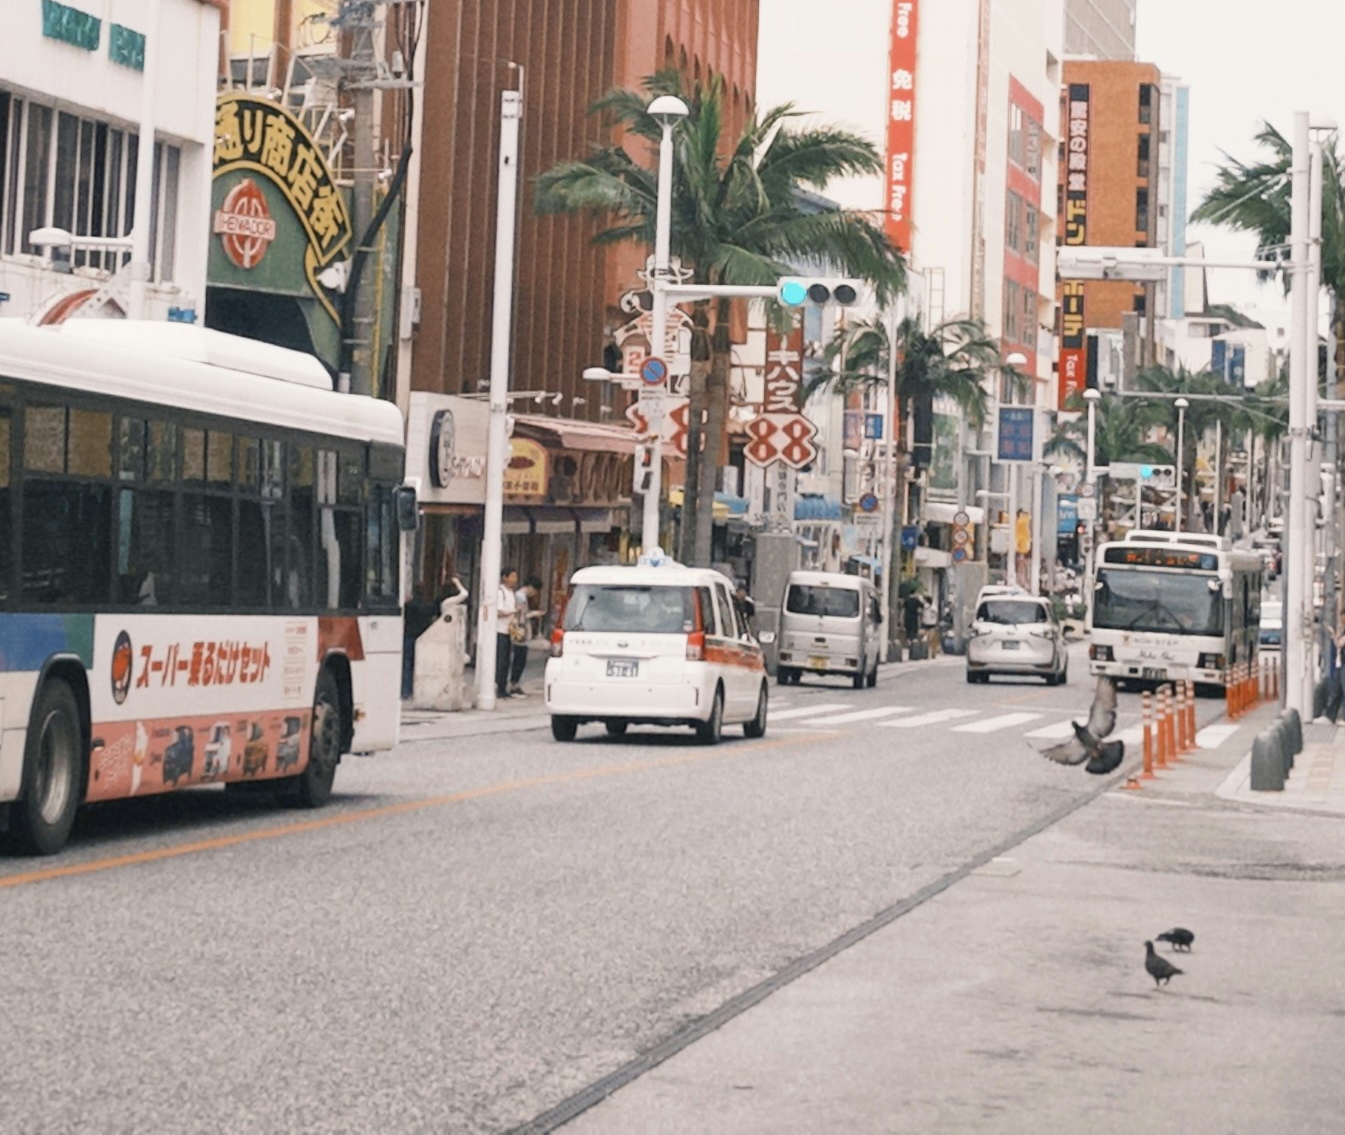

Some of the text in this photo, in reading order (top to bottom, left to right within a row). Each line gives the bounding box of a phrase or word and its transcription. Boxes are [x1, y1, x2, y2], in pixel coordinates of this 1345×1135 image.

[896, 2, 912, 38] Free
[892, 69, 913, 121] 免税
[214, 101, 344, 250] 通り商店街
[136, 640, 271, 689] スーパー乗るだけセット
